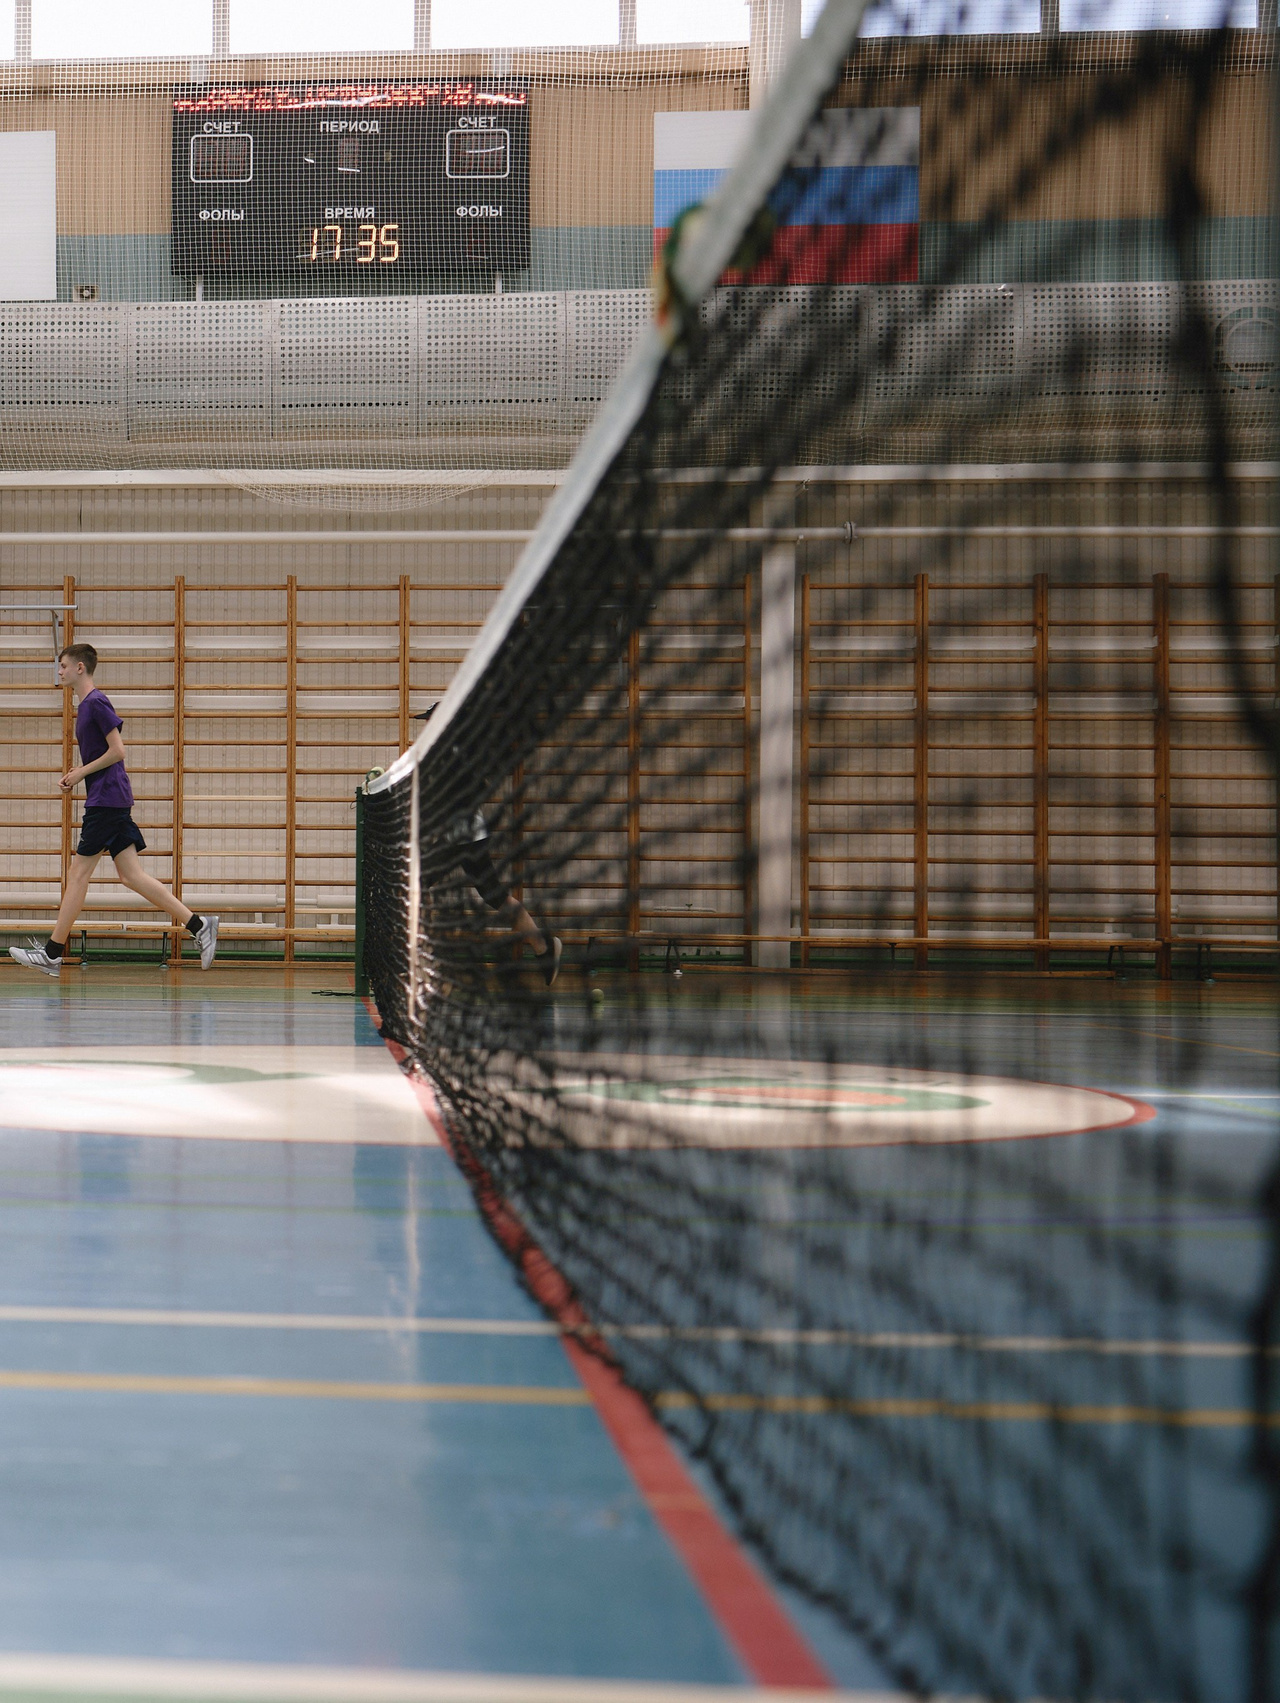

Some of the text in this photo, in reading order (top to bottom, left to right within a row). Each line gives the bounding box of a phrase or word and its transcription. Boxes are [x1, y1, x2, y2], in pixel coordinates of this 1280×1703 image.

[202, 121, 241, 134] СЧЕТ
[320, 120, 379, 134] ПЕРИОД
[458, 116, 496, 128] СЧЕТ
[198, 209, 245, 221] ФОЛЫ
[324, 207, 375, 219] ВРЕМЯ
[456, 205, 503, 217] ФОЛЫ
